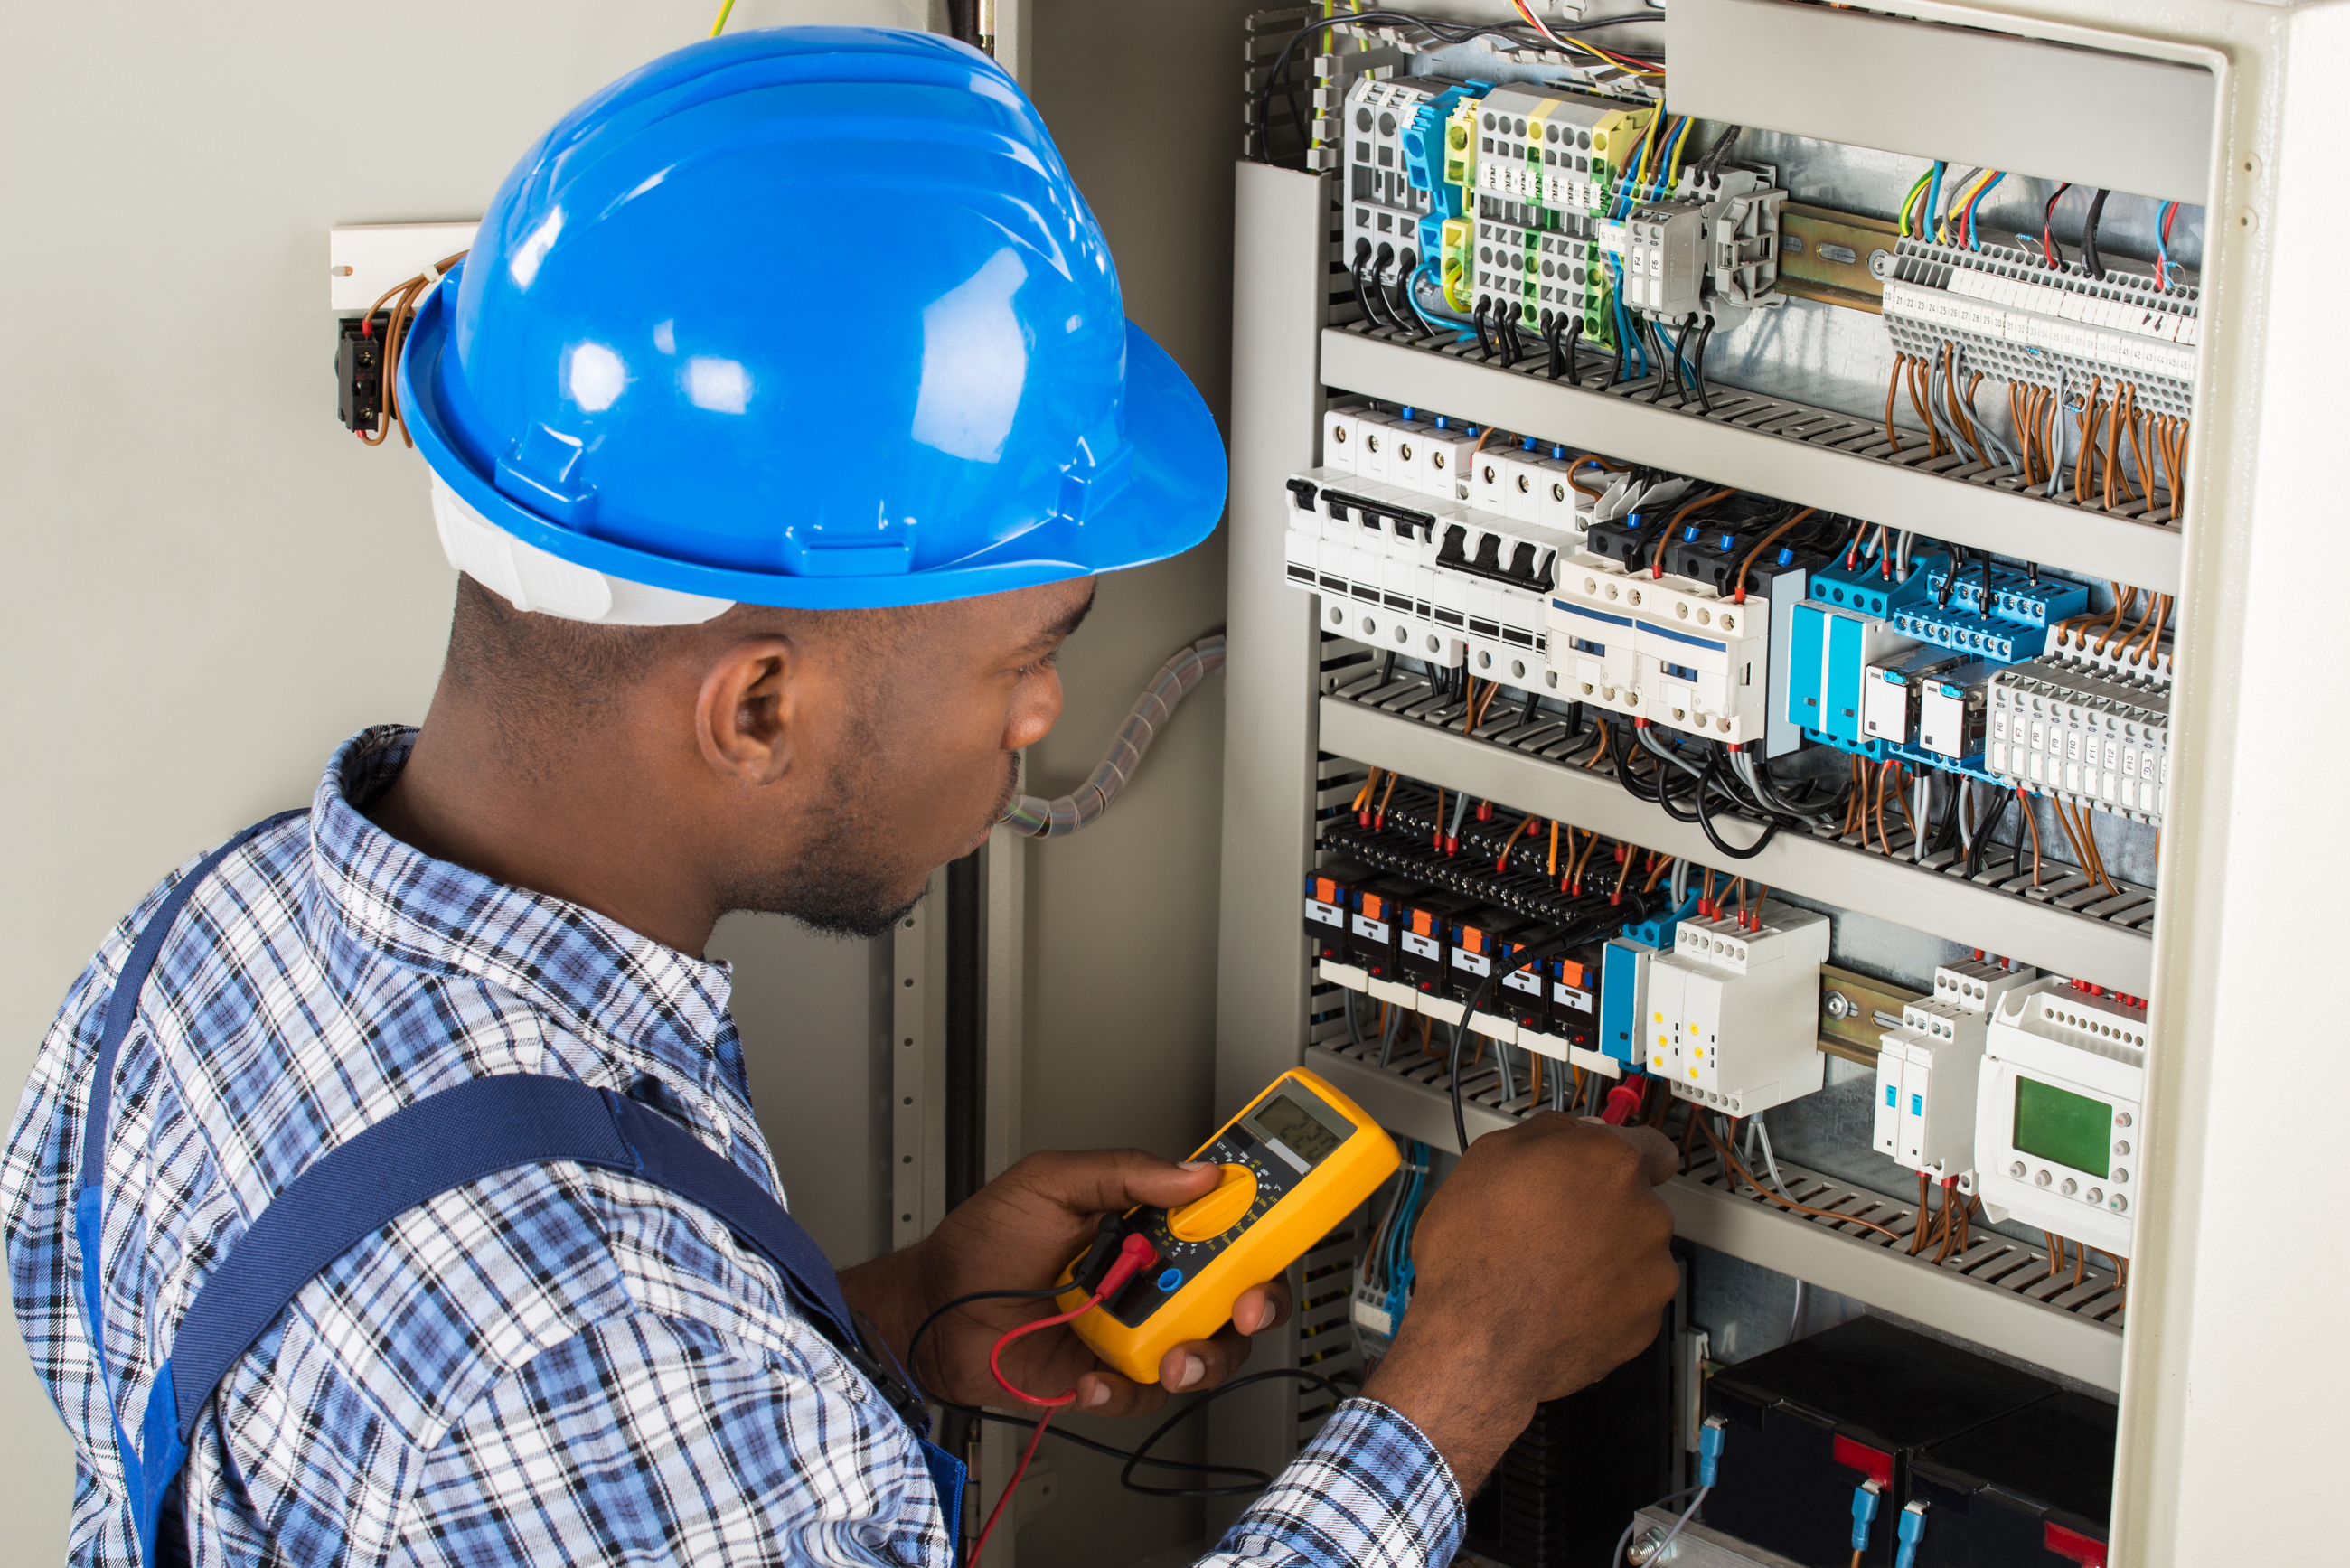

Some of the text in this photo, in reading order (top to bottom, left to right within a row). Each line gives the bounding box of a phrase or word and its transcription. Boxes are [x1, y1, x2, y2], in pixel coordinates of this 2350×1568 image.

[1611, 233, 1616, 242] 15
[1635, 256, 1641, 267] F4
[1651, 259, 1659, 270] F5
[1885, 292, 1892, 301] 20
[1896, 296, 1903, 305] 21
[1907, 298, 1913, 307] 22
[1918, 301, 1925, 310] 23
[1929, 304, 1935, 312] 24
[1940, 305, 1947, 315] 25
[1950, 308, 1958, 317] 26
[1961, 311, 1969, 320] 27
[1972, 314, 1979, 323] 28
[1983, 315, 1990, 325] 29
[1995, 318, 2002, 327] 30
[2007, 323, 2014, 331] 31
[2018, 324, 2025, 333] 32
[2030, 327, 2037, 336] 33
[2041, 330, 2048, 339] 34
[2053, 333, 2059, 342] 35
[2064, 334, 2071, 343] 36
[2075, 337, 2082, 346] 37
[2087, 340, 2094, 349] 38
[2099, 343, 2106, 352] 39
[2110, 345, 2118, 353] 40
[2122, 348, 2129, 356] 41
[2134, 351, 2141, 360] 42
[2146, 353, 2153, 362] 43
[2168, 358, 2176, 367] 45
[2180, 361, 2187, 370] 46
[356, 373, 365, 381] NC
[1996, 722, 2003, 732] F6
[2016, 727, 2022, 737] F7
[2033, 732, 2040, 742] F8
[2052, 738, 2059, 748] F9
[1225, 1150, 1233, 1159] 200
